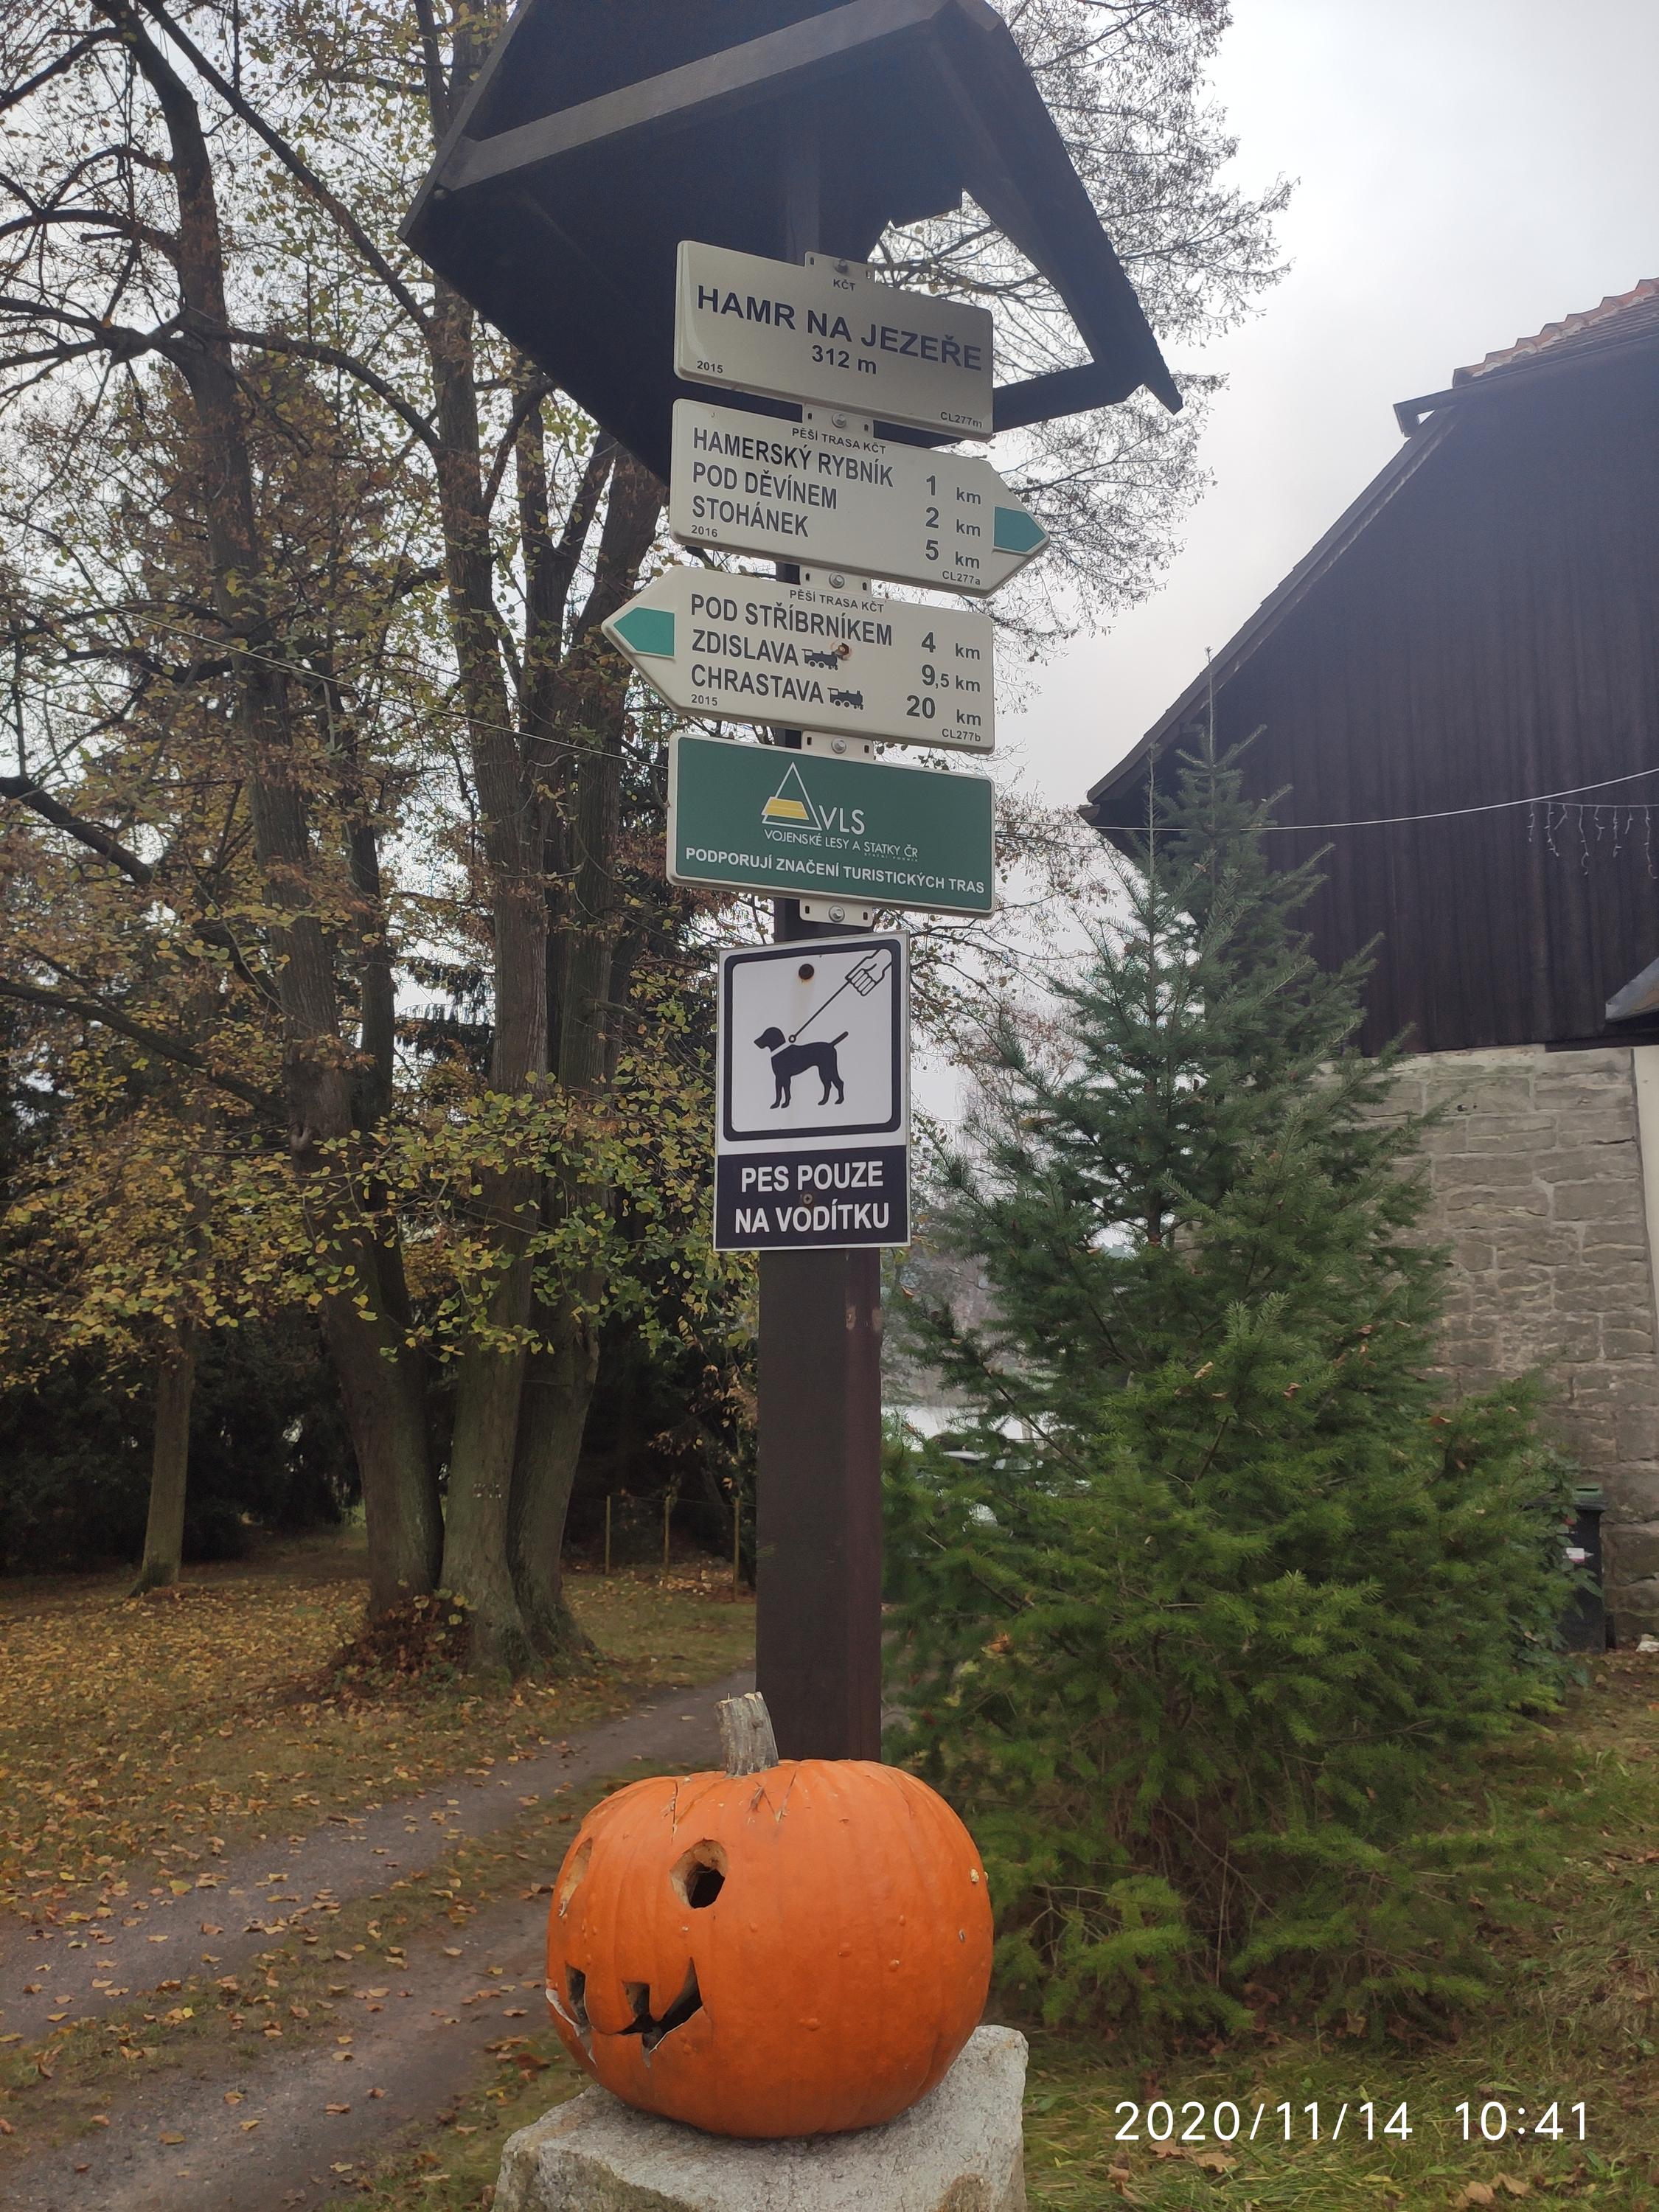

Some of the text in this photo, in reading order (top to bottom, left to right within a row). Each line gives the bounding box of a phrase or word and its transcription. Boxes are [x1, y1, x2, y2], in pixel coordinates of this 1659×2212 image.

[833, 279, 855, 291] KČT
[698, 285, 982, 371] HAMR NA JEZEŘE
[697, 360, 723, 374] 2015
[812, 344, 877, 375] 312 m
[792, 426, 886, 454] PĚŠÍ TRASA KČT
[693, 427, 894, 487] HAMERSKÝ RYBNÍK
[692, 462, 837, 509] POD DĚVÍNEM
[925, 475, 982, 505] 1 km
[691, 524, 718, 538] 2016
[692, 495, 809, 538] STOHÁNEK
[925, 507, 981, 538] 2 km
[925, 539, 981, 570] 5 km
[942, 570, 981, 586] CL277a
[789, 588, 884, 614] PĚŠÍ TRASA KČT
[691, 594, 892, 646] POD STŘÍBRNÍKEM
[692, 629, 799, 666] ZDISLAVA
[921, 632, 981, 661] 4 km
[691, 664, 824, 705] CHRASTAVA
[921, 664, 981, 693] 9,5 km
[691, 694, 718, 707] 2015
[905, 695, 981, 727] 20 km
[942, 728, 981, 742] CL277b
[818, 805, 865, 835] VLS
[764, 828, 822, 847] VOJENSKÉ
[825, 836, 849, 851] LESY
[852, 841, 861, 852] A
[863, 841, 900, 855] STATKY
[904, 844, 918, 858] ČR
[686, 847, 772, 870] PODPORUJÍ
[776, 856, 840, 877] ZNAČENÍ
[842, 866, 945, 891] TURISTICKÝCH
[948, 878, 985, 894] TRAS
[741, 1161, 883, 1192] PES POUZE
[734, 1198, 889, 1234] NA VODÍTKU
